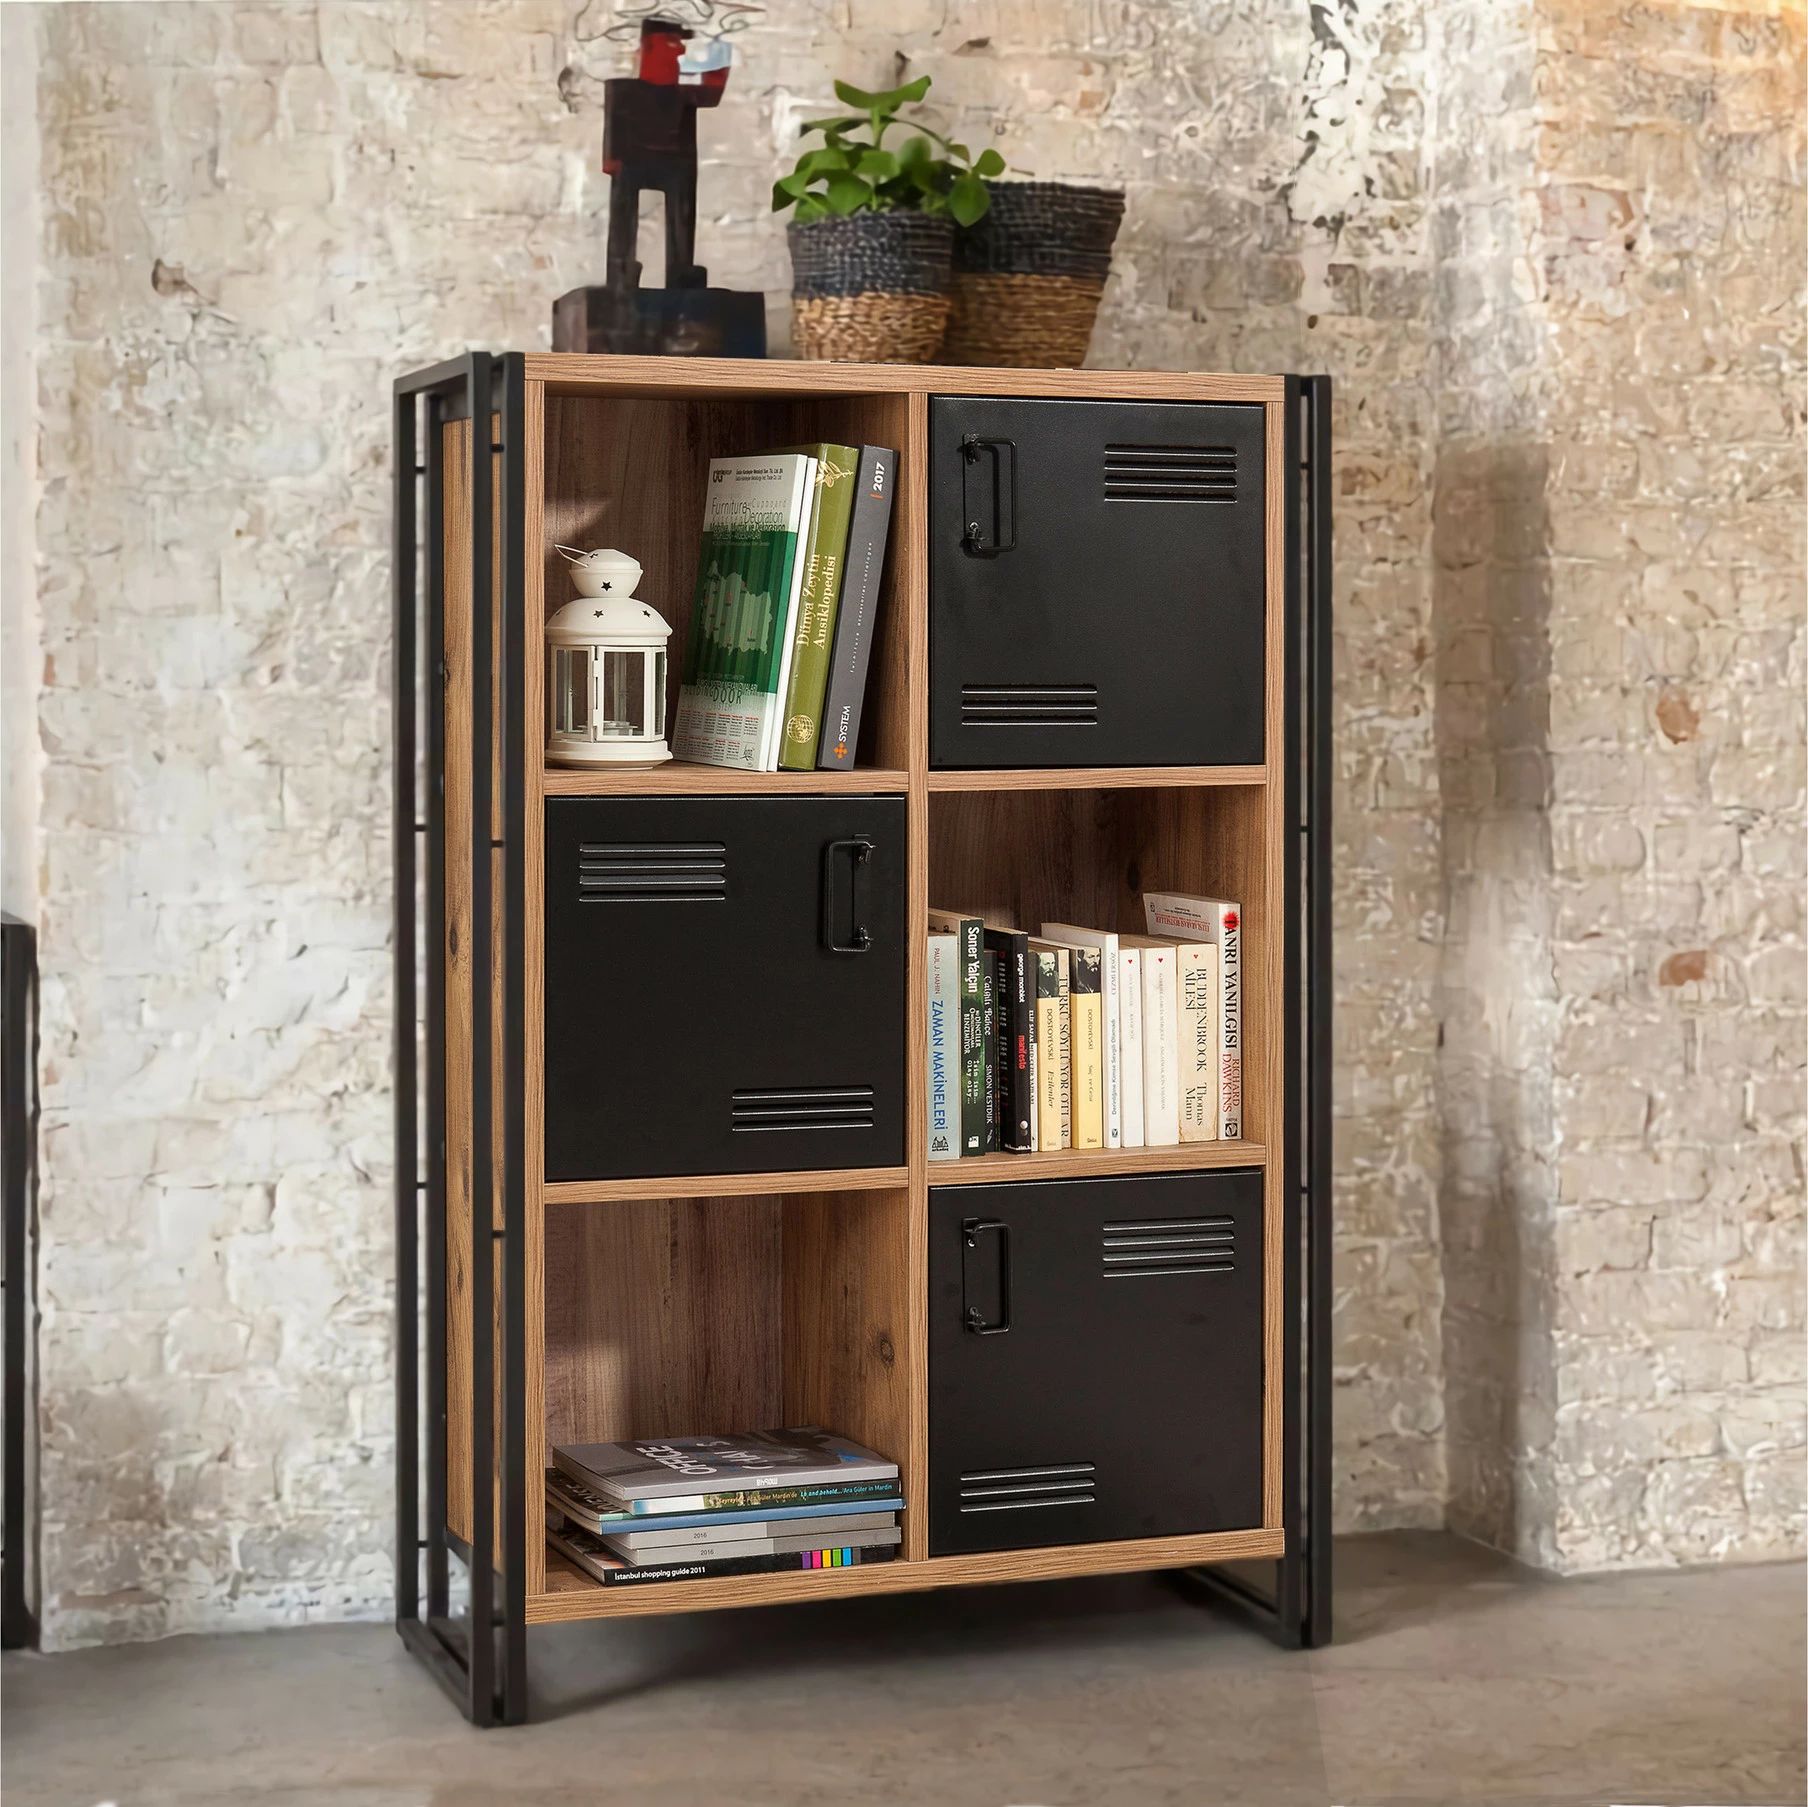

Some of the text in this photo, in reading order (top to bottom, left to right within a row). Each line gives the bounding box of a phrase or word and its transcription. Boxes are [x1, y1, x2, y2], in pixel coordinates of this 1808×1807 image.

[873, 461, 885, 492] 2017
[711, 497, 747, 515] Furniture
[796, 553, 821, 647] Dünya Zeytin
[813, 555, 837, 650] Ansiklopedisi
[850, 541, 874, 674] furniture accessories catalogue
[712, 686, 743, 705] DOOR
[838, 704, 851, 743] SYSTEM
[965, 926, 981, 994] Soner Yalçın
[1016, 953, 1024, 976] george
[1224, 917, 1239, 1049] TANRI YANILGISI
[1196, 968, 1207, 1072] BUDDENBROOK
[932, 1000, 948, 1131] ZAMAN MAKİNELERİ
[1018, 1035, 1027, 1070] manifesto
[1047, 1070, 1055, 1108] Ezilenler
[1222, 1053, 1233, 1113] DAWKINS
[1232, 1058, 1240, 1107] RICHARD
[1185, 1088, 1196, 1121] Mann
[1196, 1082, 1207, 1126] Thomas
[808, 1489, 819, 1497] and
[843, 1487, 853, 1495] Ara
[853, 1485, 867, 1494] Güler
[874, 1483, 893, 1492] Mardin
[641, 1568, 672, 1580] shopping
[671, 1567, 690, 1578] guide
[690, 1566, 706, 1575] 2011
